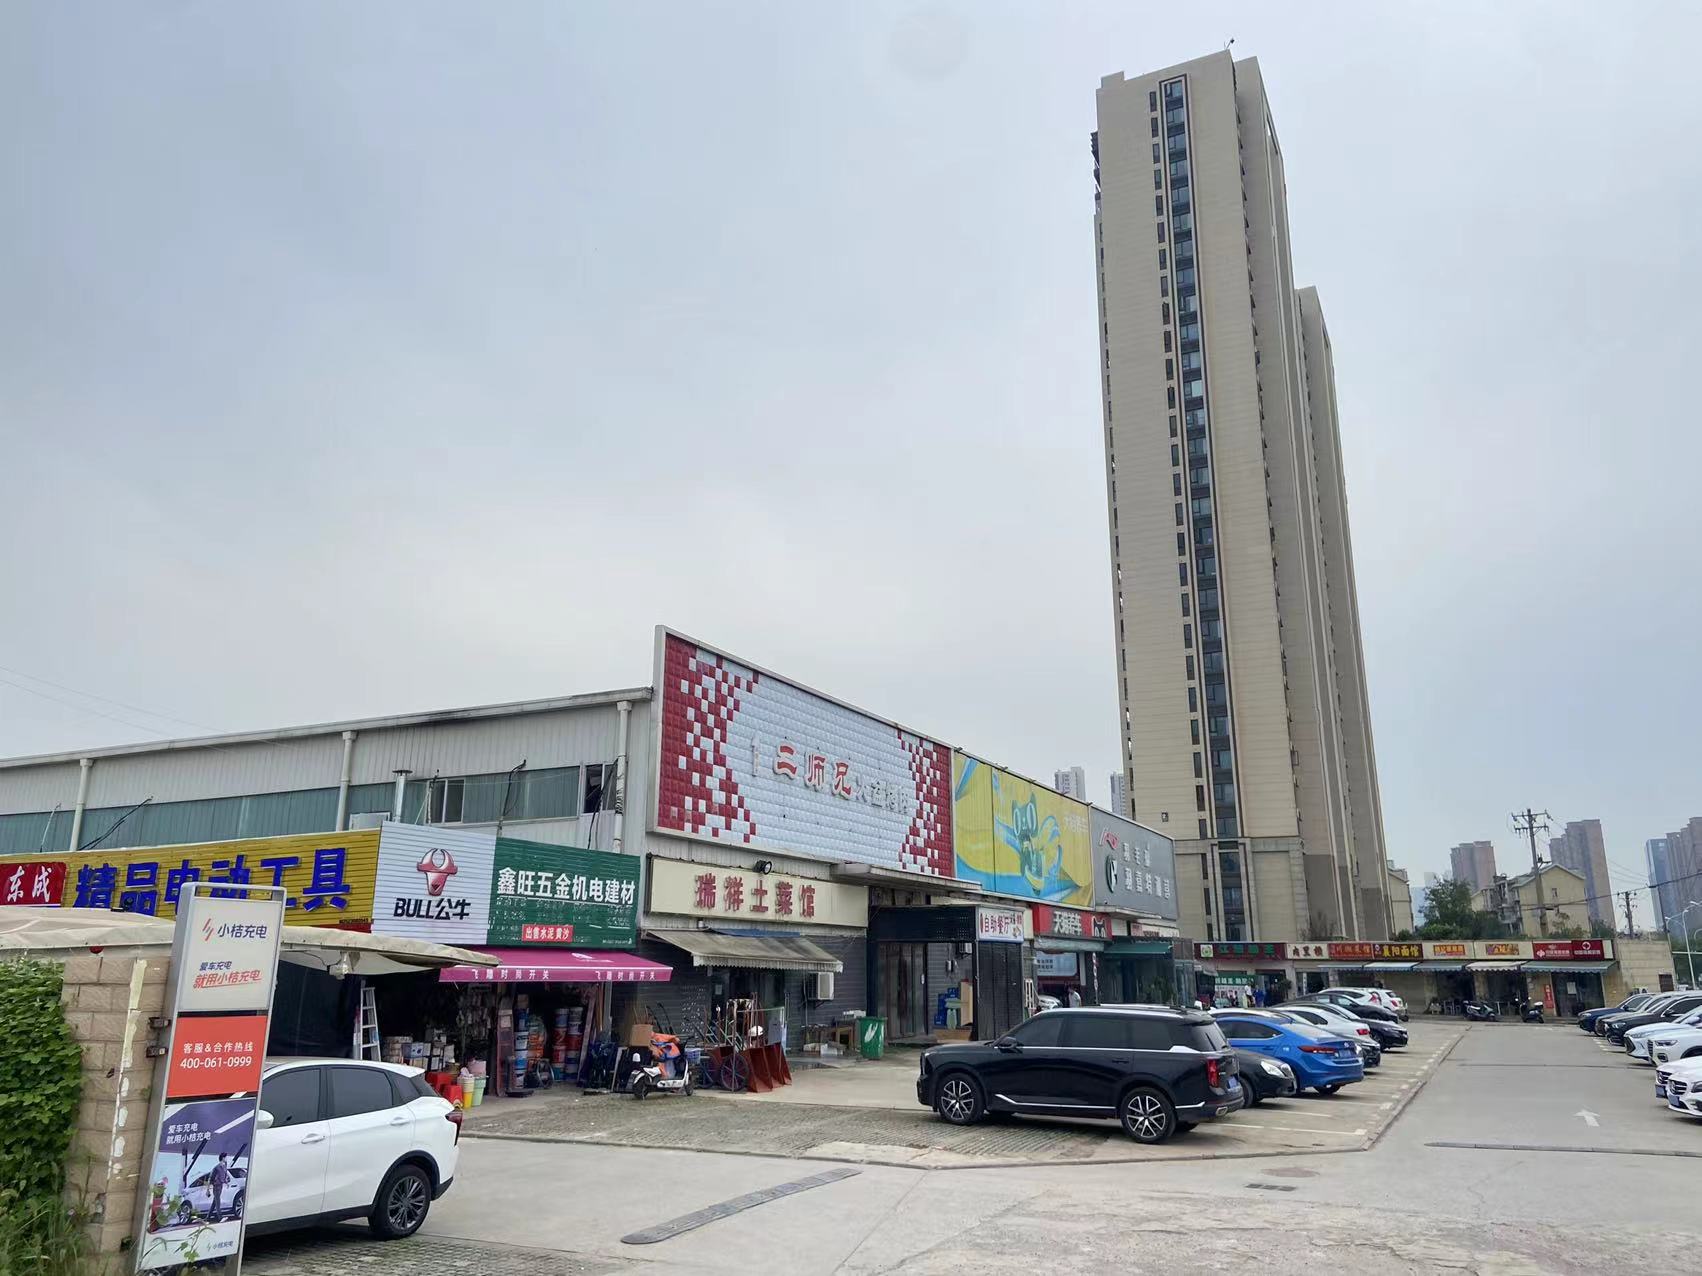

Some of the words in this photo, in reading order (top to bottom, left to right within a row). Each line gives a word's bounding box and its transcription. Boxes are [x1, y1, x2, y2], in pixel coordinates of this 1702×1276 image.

[7, 866, 54, 903] 东成
[73, 848, 350, 917] 精品电动工具
[497, 867, 636, 906] 鑫旺五金机电建材
[694, 872, 816, 918] 瑞祥土菜馆
[217, 923, 268, 939] 小桔充电
[525, 927, 570, 941] 出售水泥黄沙
[1383, 944, 1420, 958] 襄阳面馆
[199, 961, 233, 972] 爱车充电
[194, 970, 262, 988] 就用小桔充电
[183, 1042, 254, 1054] 客服&合作热线
[180, 1056, 252, 1069] 400-061-0999
[168, 1122, 199, 1134] 爱车充电
[166, 1131, 211, 1145] 就用小桔充电
